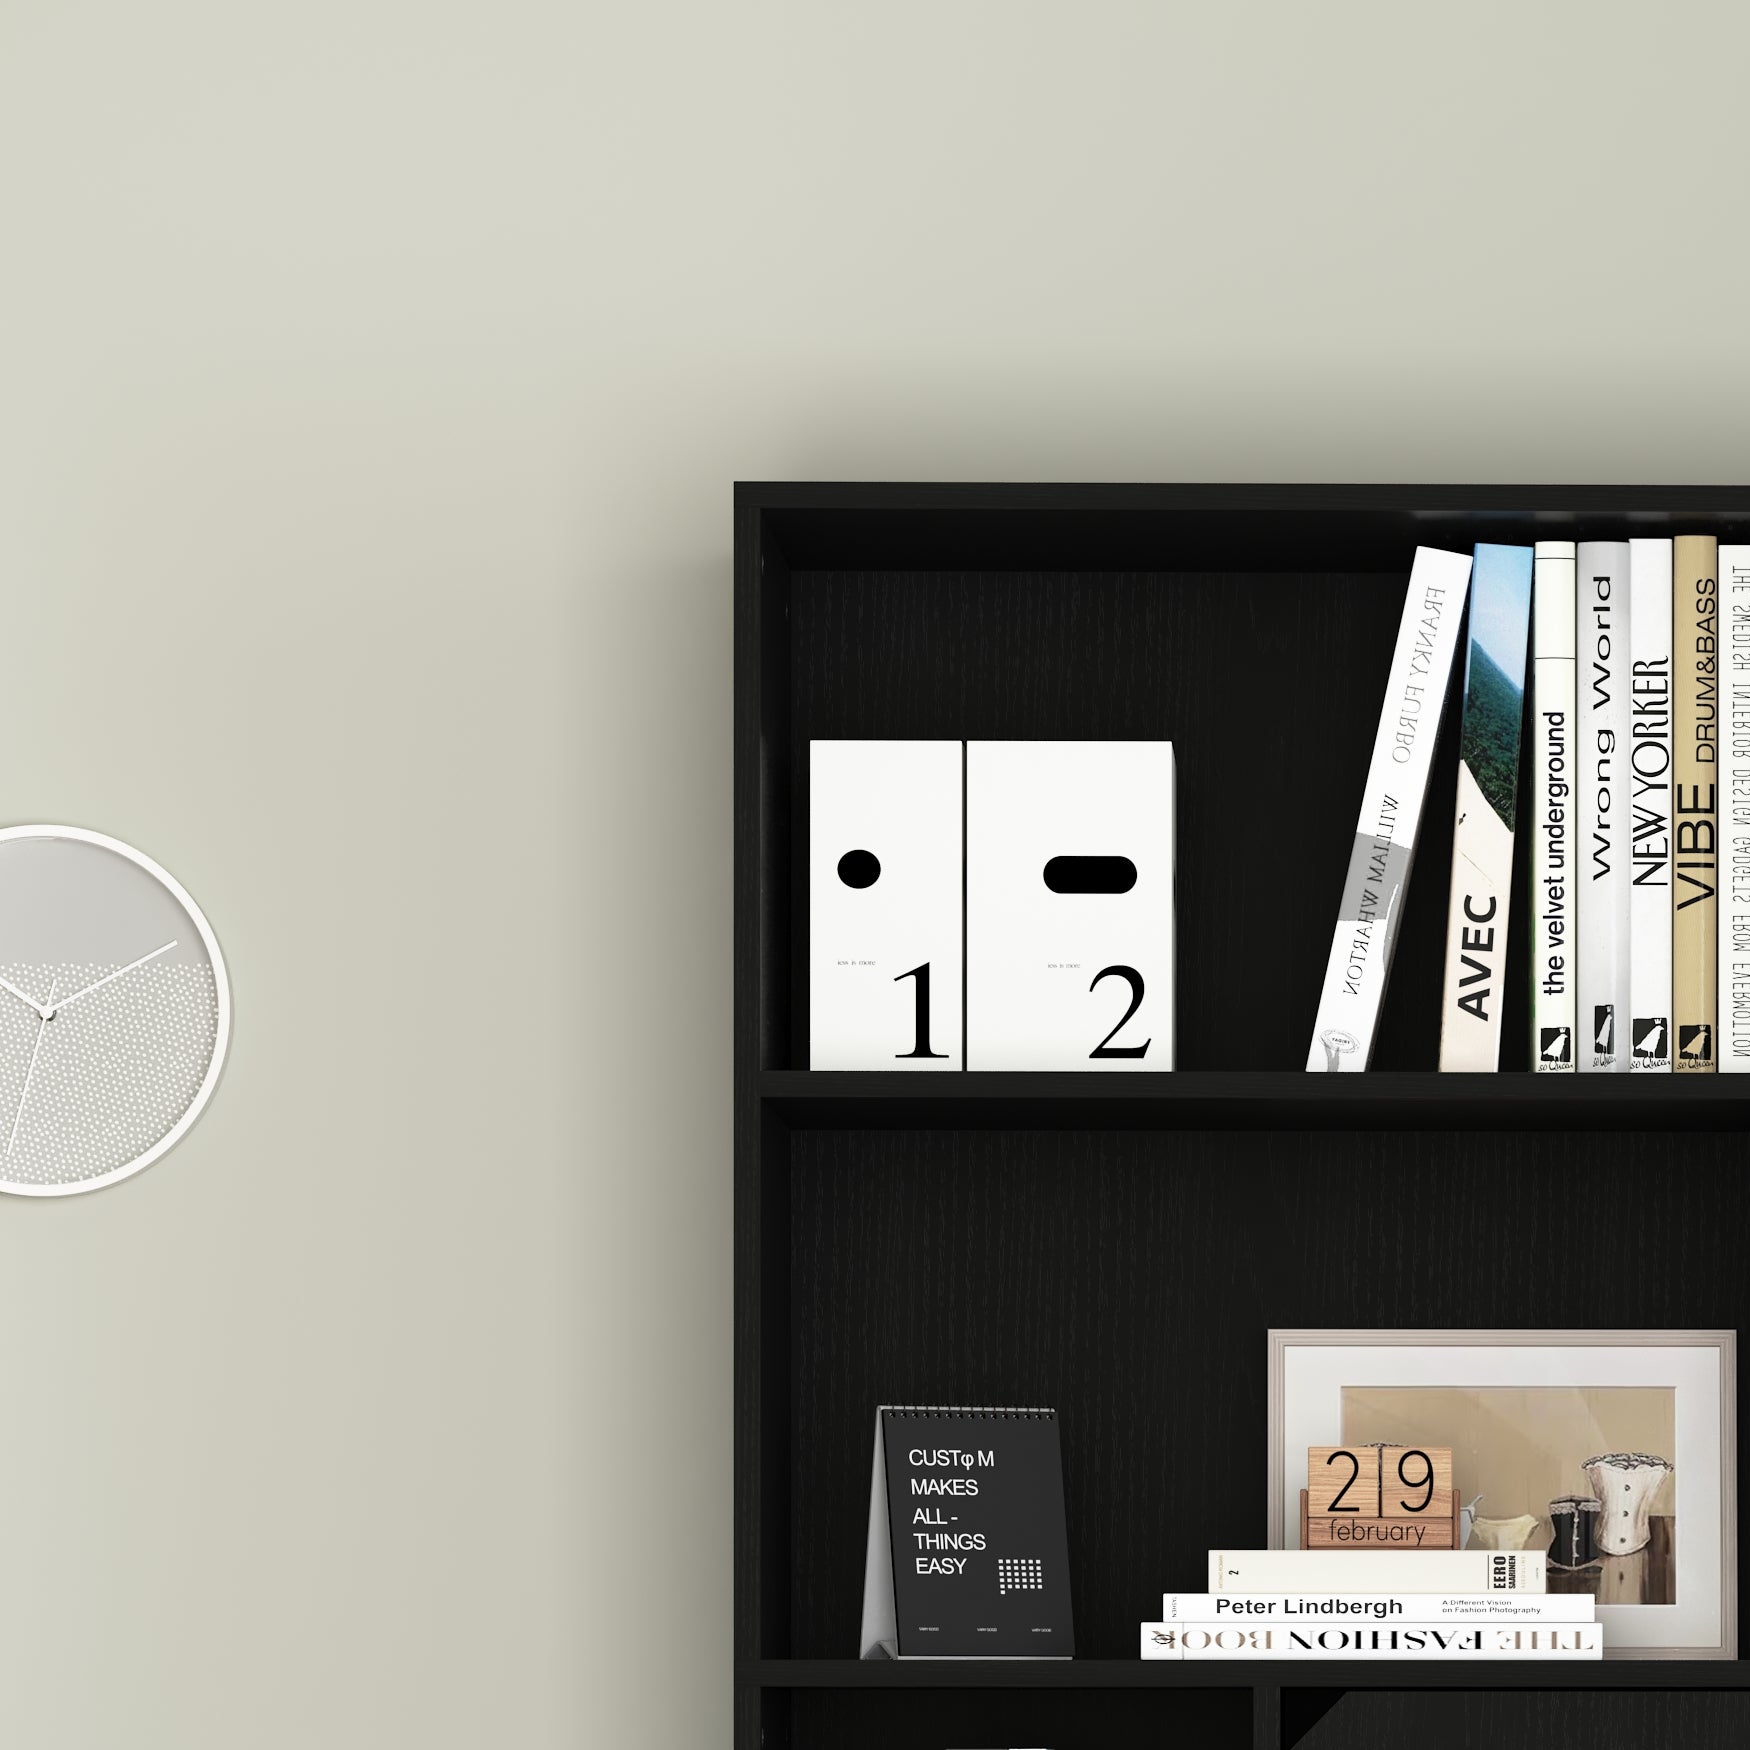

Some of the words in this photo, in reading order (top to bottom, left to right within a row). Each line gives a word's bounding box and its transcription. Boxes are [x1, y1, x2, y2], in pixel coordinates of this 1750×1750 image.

[1592, 576, 1611, 711] World
[1695, 578, 1716, 764] DRUM&BASS
[1631, 655, 1670, 797] YORKER
[1542, 711, 1569, 874] underground
[1592, 729, 1616, 881] Wrong
[1632, 805, 1668, 886] NEW
[1676, 783, 1716, 910] VIBE
[1542, 875, 1565, 947] velvet
[1457, 894, 1498, 1023] AVEC
[1542, 951, 1565, 995] the
[893, 961, 950, 1059] 1
[1088, 965, 1152, 1059] 2
[910, 1478, 979, 1496] MAKES
[912, 1533, 987, 1550] THINGS
[1328, 1518, 1426, 1546] february
[915, 1557, 967, 1575] EASY
[1493, 1556, 1507, 1589] EERO
[1508, 1555, 1516, 1589] SAARINEN
[1215, 1598, 1278, 1615] Peter
[1284, 1598, 1404, 1619] Lindbergh
[1489, 1607, 1541, 1615] Photography
[1289, 1630, 1486, 1650] FASHION
[1499, 1630, 1594, 1650] THE
